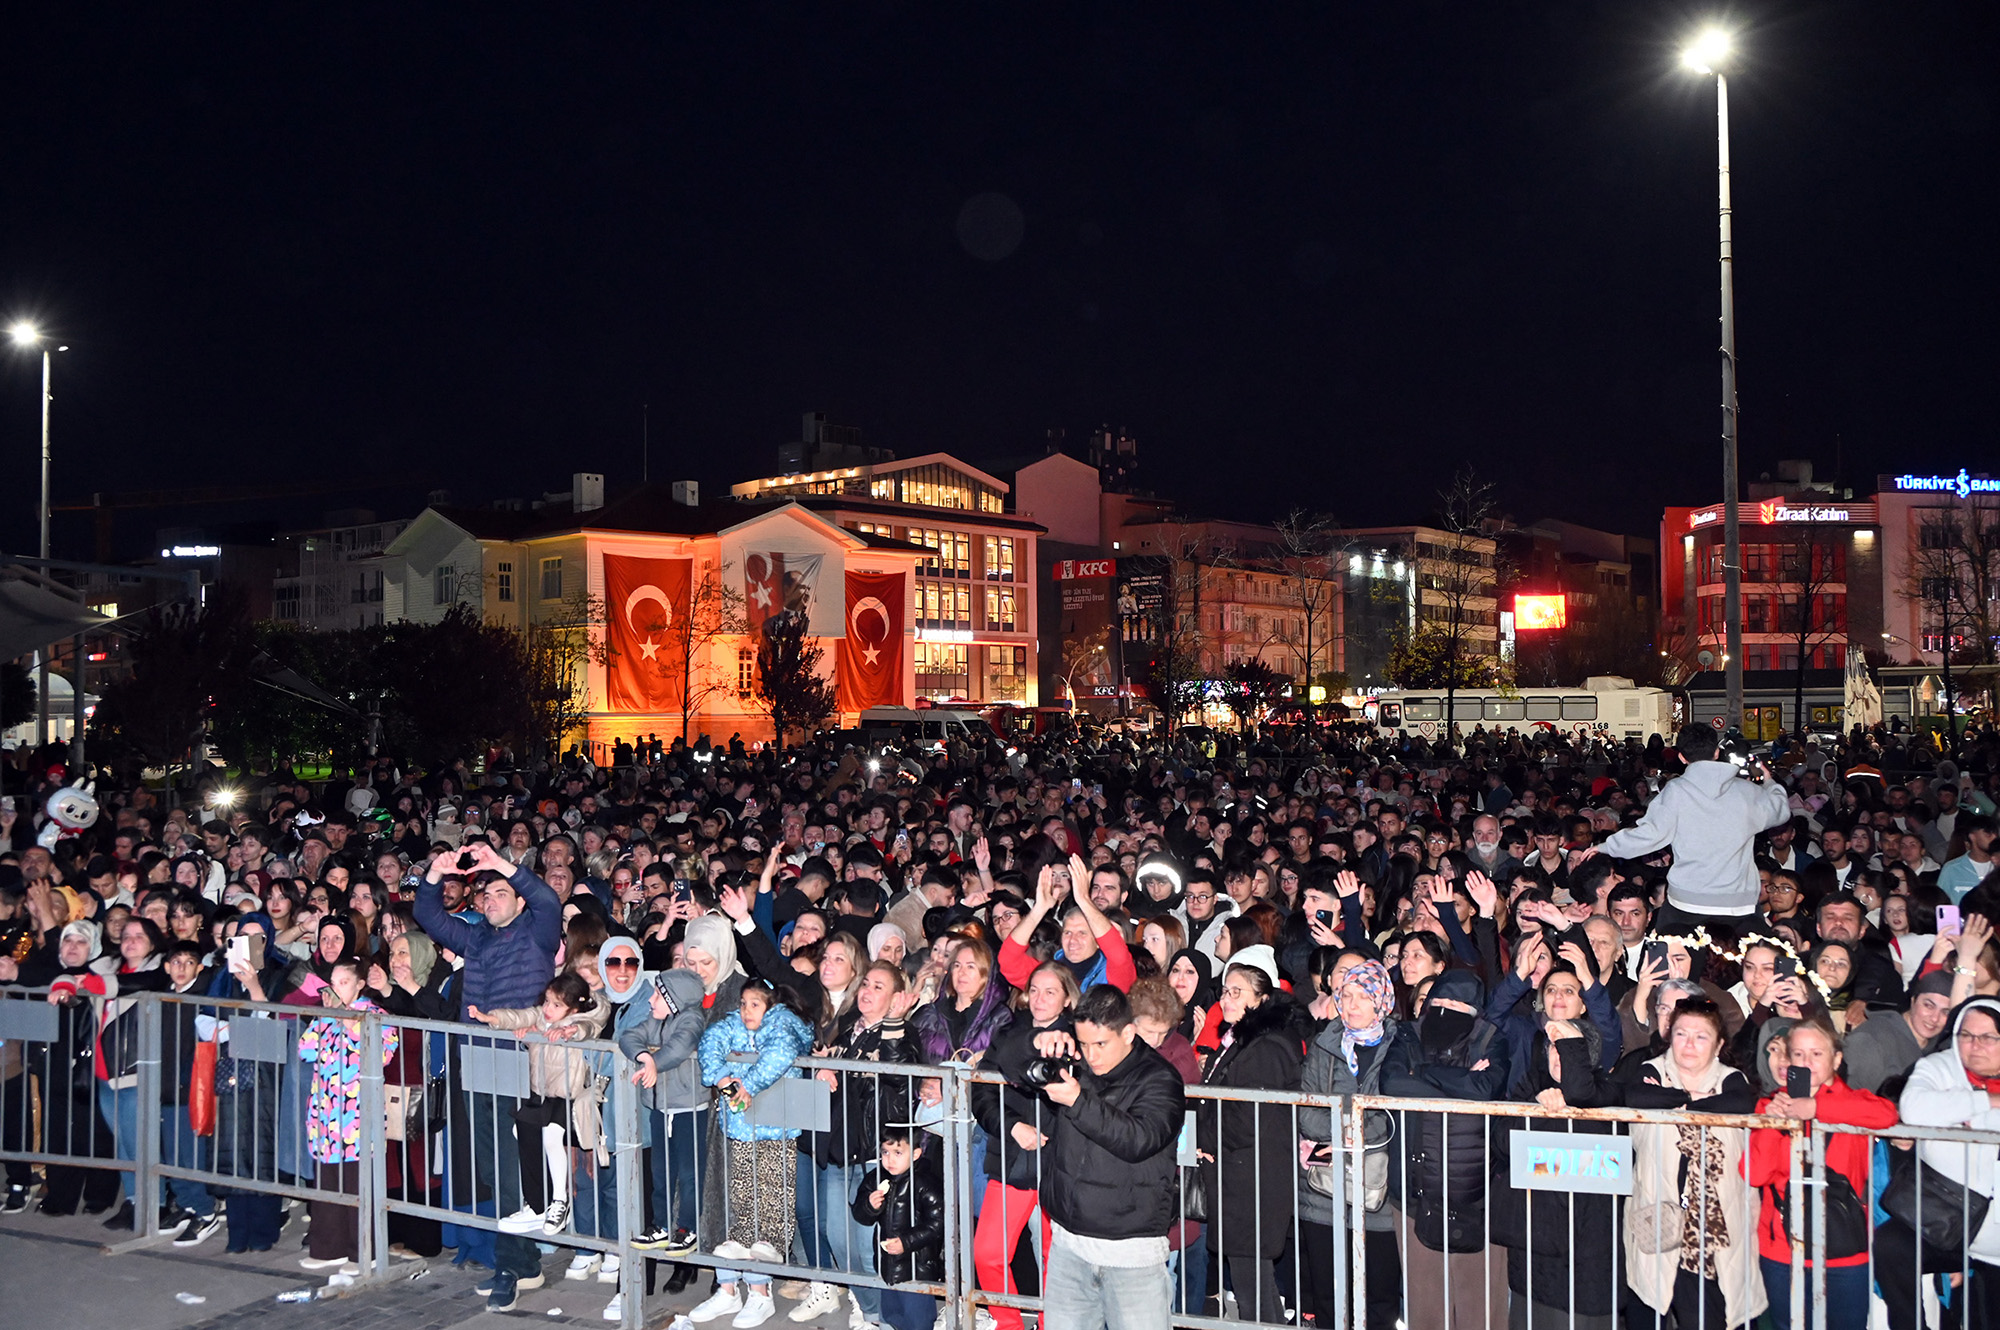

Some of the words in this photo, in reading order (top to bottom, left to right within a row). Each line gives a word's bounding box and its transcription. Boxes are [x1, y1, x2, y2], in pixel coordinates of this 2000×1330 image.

[1894, 474, 1956, 490] TÜRKİYE
[1775, 506, 1809, 521] Ziraat
[1078, 561, 1109, 576] KFC
[1094, 686, 1115, 696] KFC
[1592, 722, 1609, 730] 168
[1526, 1143, 1621, 1179] POLİS
